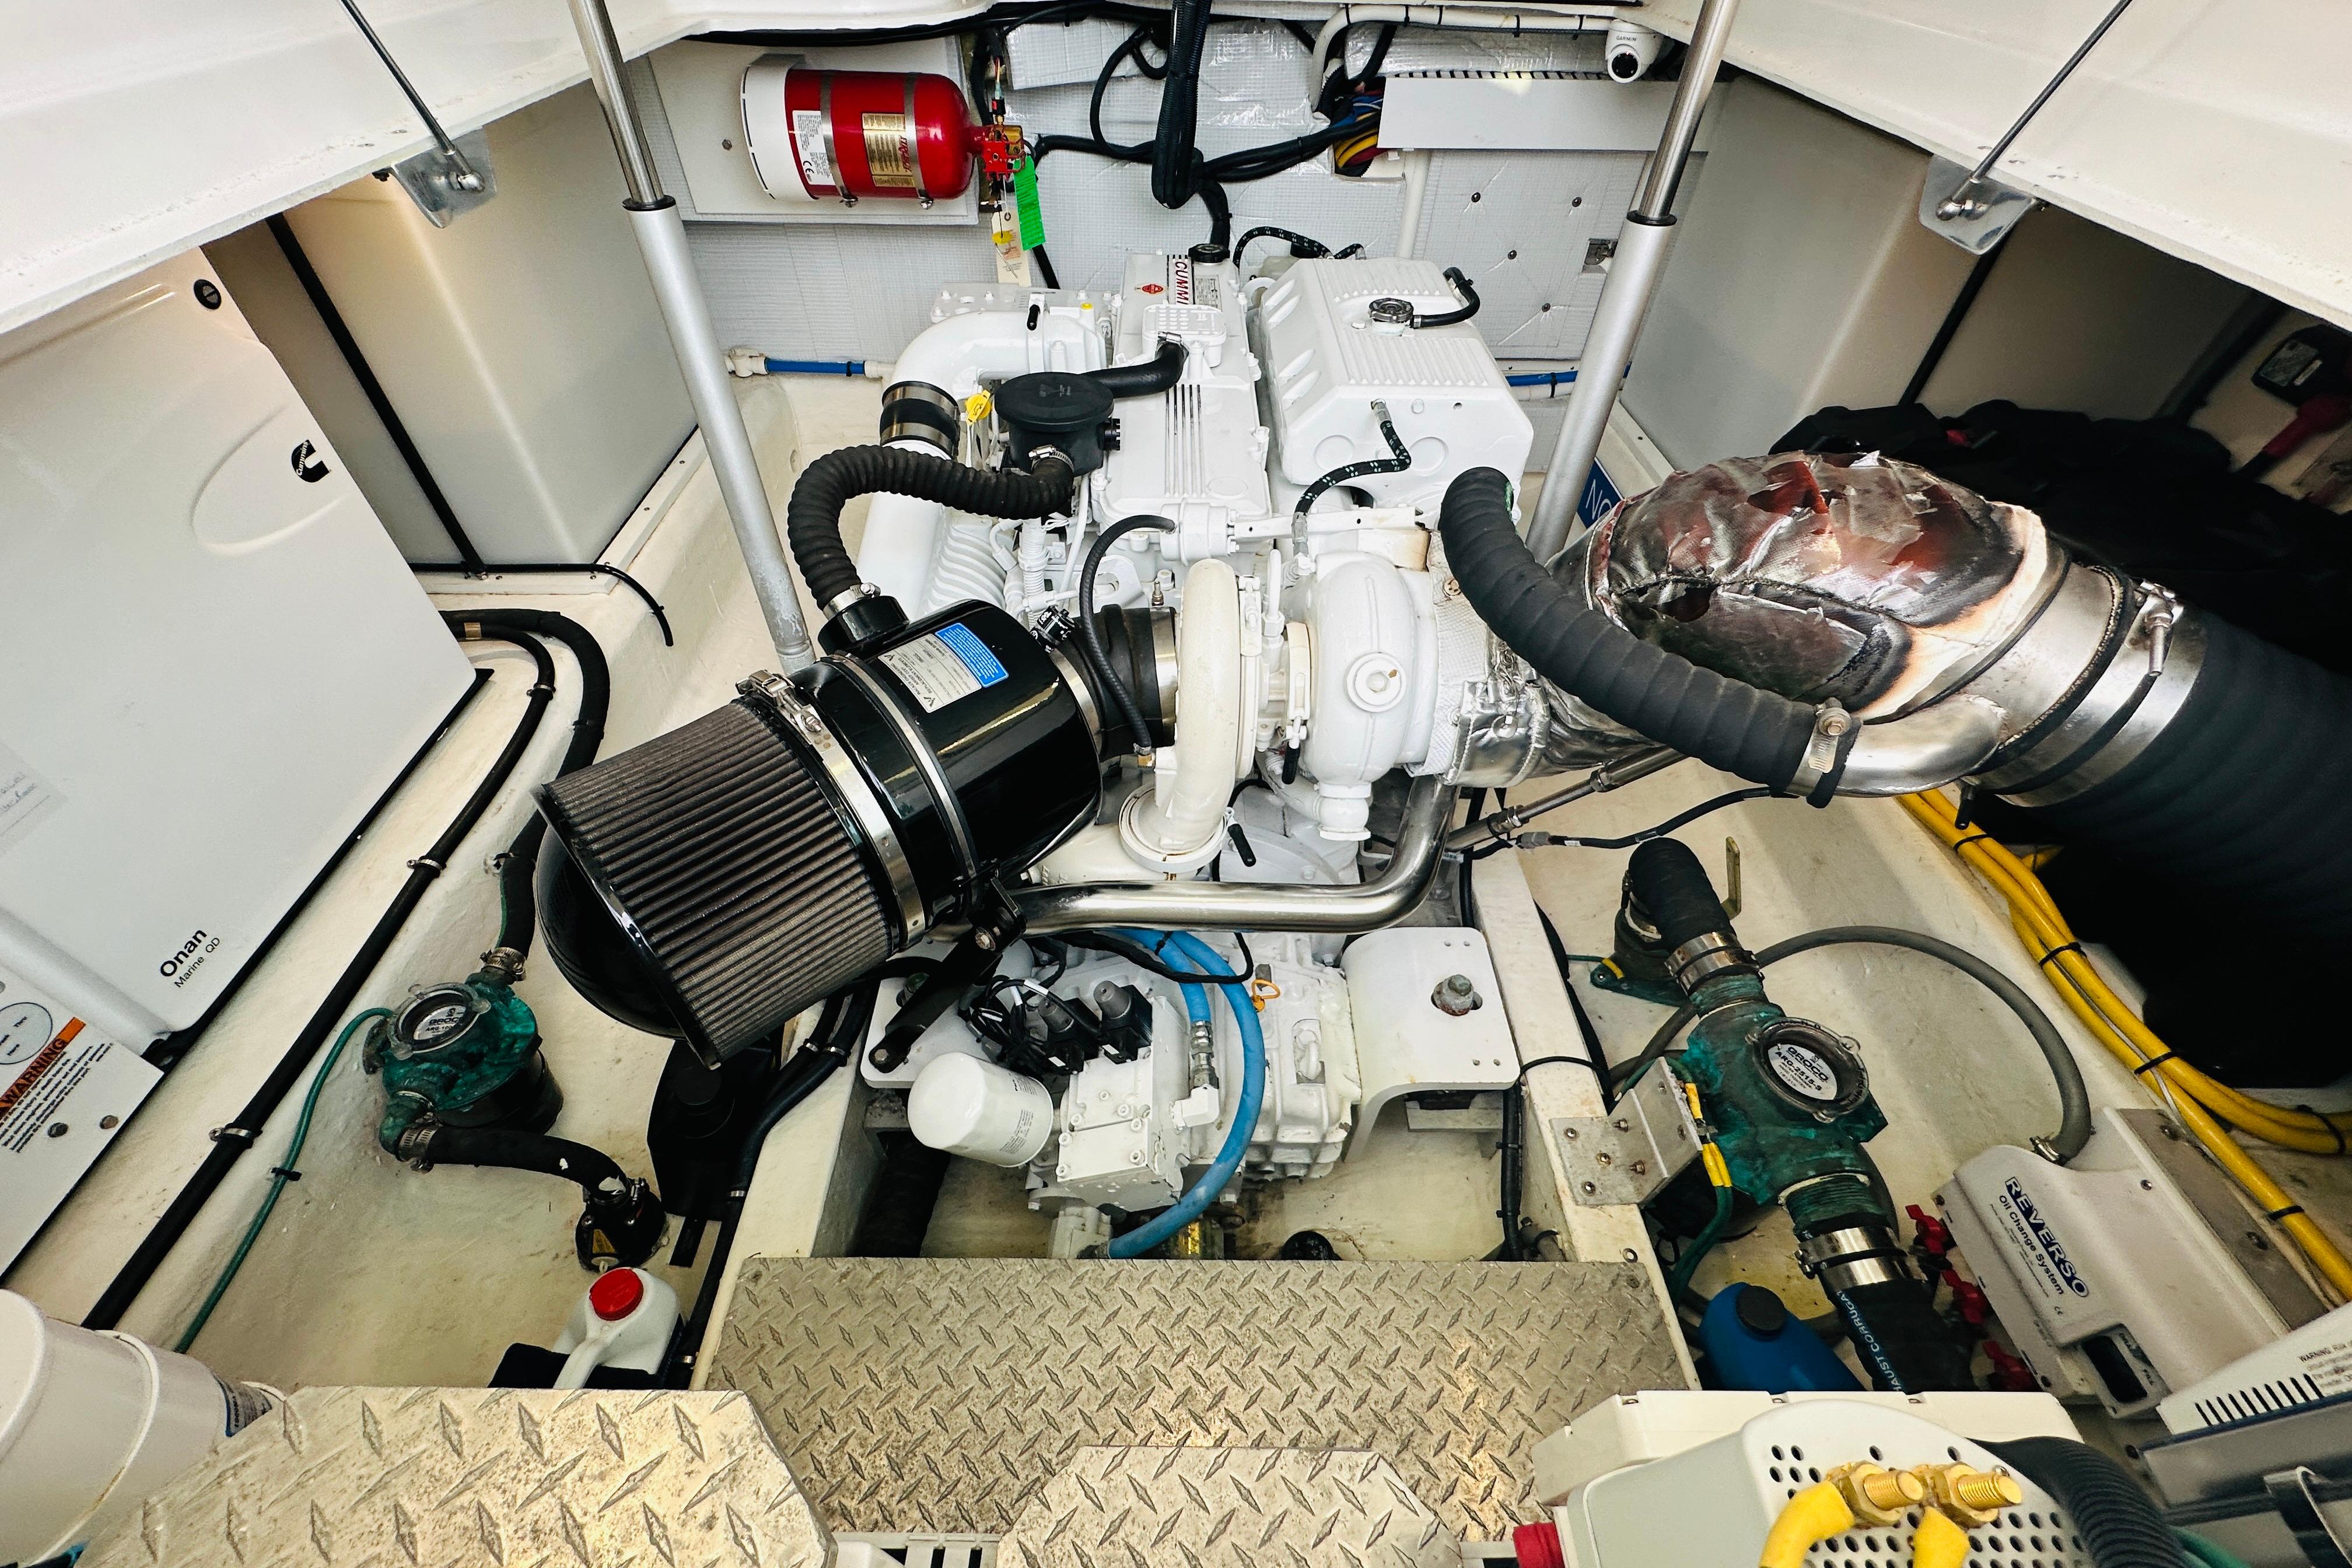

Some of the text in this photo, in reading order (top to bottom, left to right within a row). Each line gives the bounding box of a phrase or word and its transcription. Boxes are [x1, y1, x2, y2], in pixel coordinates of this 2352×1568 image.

[1175, 261, 1188, 304] CUMMI
[296, 441, 309, 475] Cummins
[160, 928, 207, 977] Onan
[173, 936, 221, 988] Marine QD
[1, 1038, 66, 1105] WARNING
[1774, 1051, 1822, 1091] ARG-2515-S
[1787, 1045, 1829, 1082] GROCO
[1998, 1194, 2012, 1210] Oil
[2008, 1210, 2038, 1252] Change
[2035, 1252, 2065, 1295] System
[2006, 1176, 2087, 1297] REVERSO
